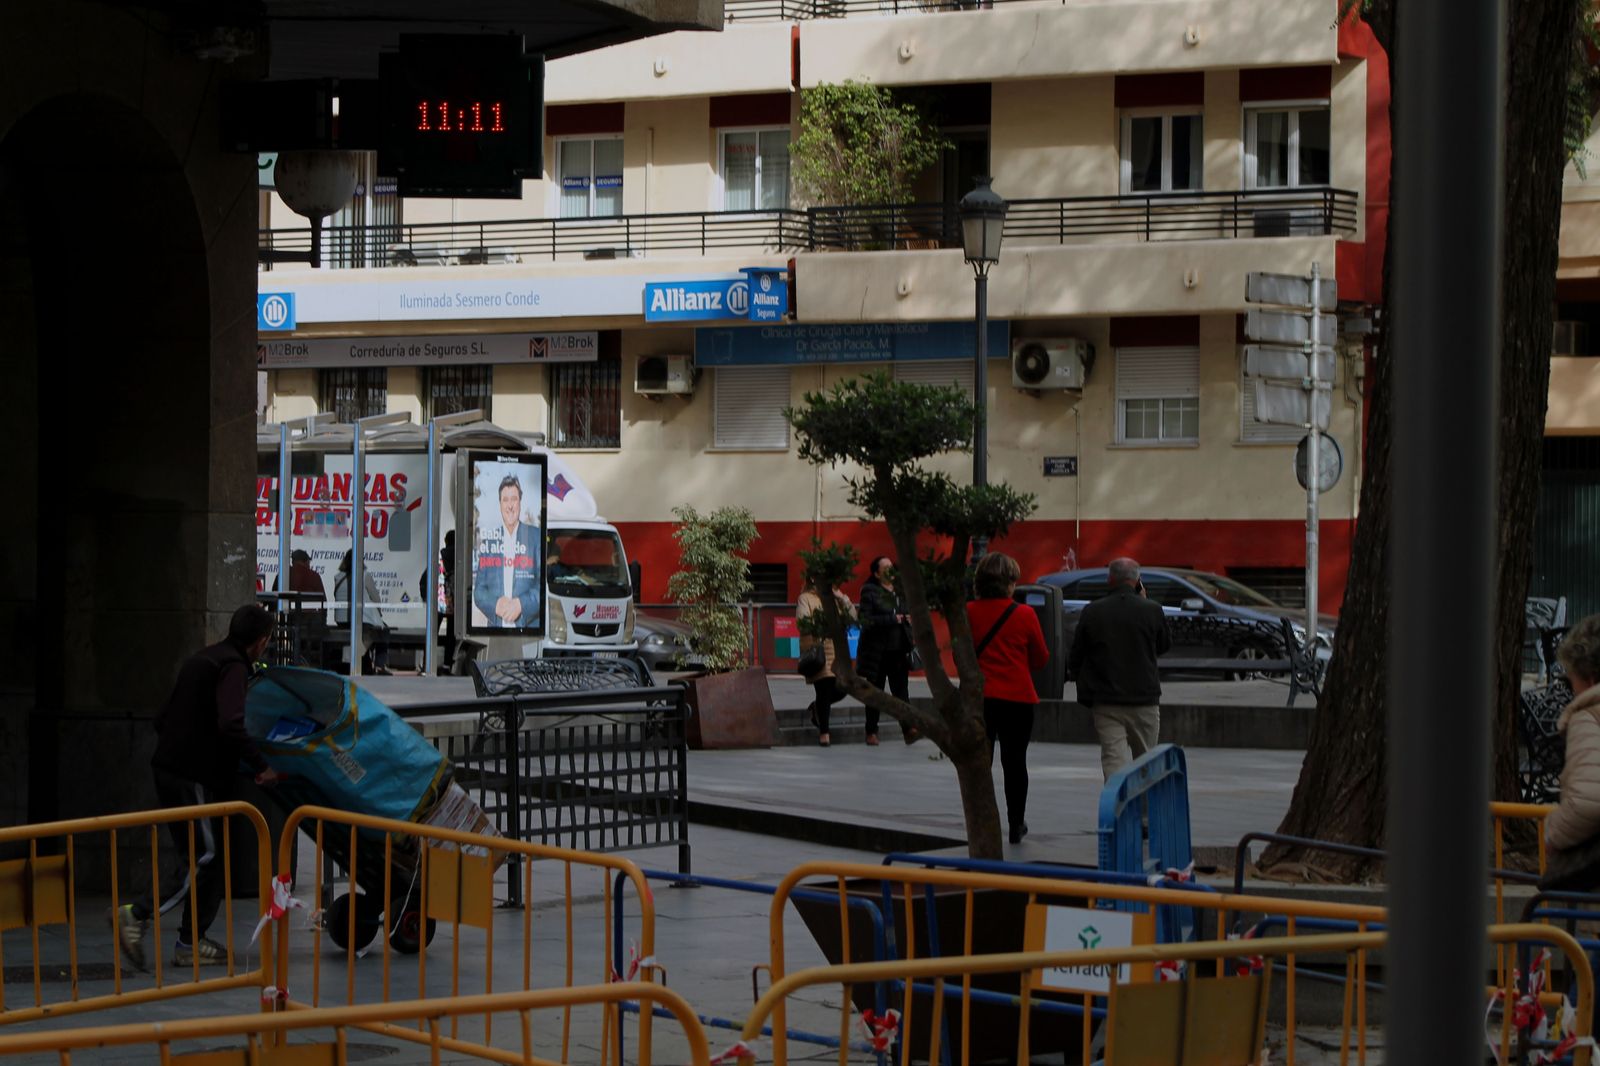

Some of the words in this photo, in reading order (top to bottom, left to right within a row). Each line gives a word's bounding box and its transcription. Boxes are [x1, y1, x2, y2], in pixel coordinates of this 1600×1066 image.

[417, 101, 505, 133] 11:11
[400, 293, 452, 309] Iluminada
[455, 292, 502, 307] Sesmero
[505, 291, 540, 306] Conde
[651, 287, 722, 312] Allianz
[753, 293, 779, 306] Allianz
[757, 308, 776, 319] Seguros
[794, 326, 806, 338] de
[550, 335, 594, 349] M2Brok
[268, 343, 309, 356] M2Brok
[408, 344, 421, 357] de
[424, 343, 467, 359] Seguros
[471, 342, 489, 356] S.L.
[480, 541, 490, 554] el
[479, 556, 502, 570] para
